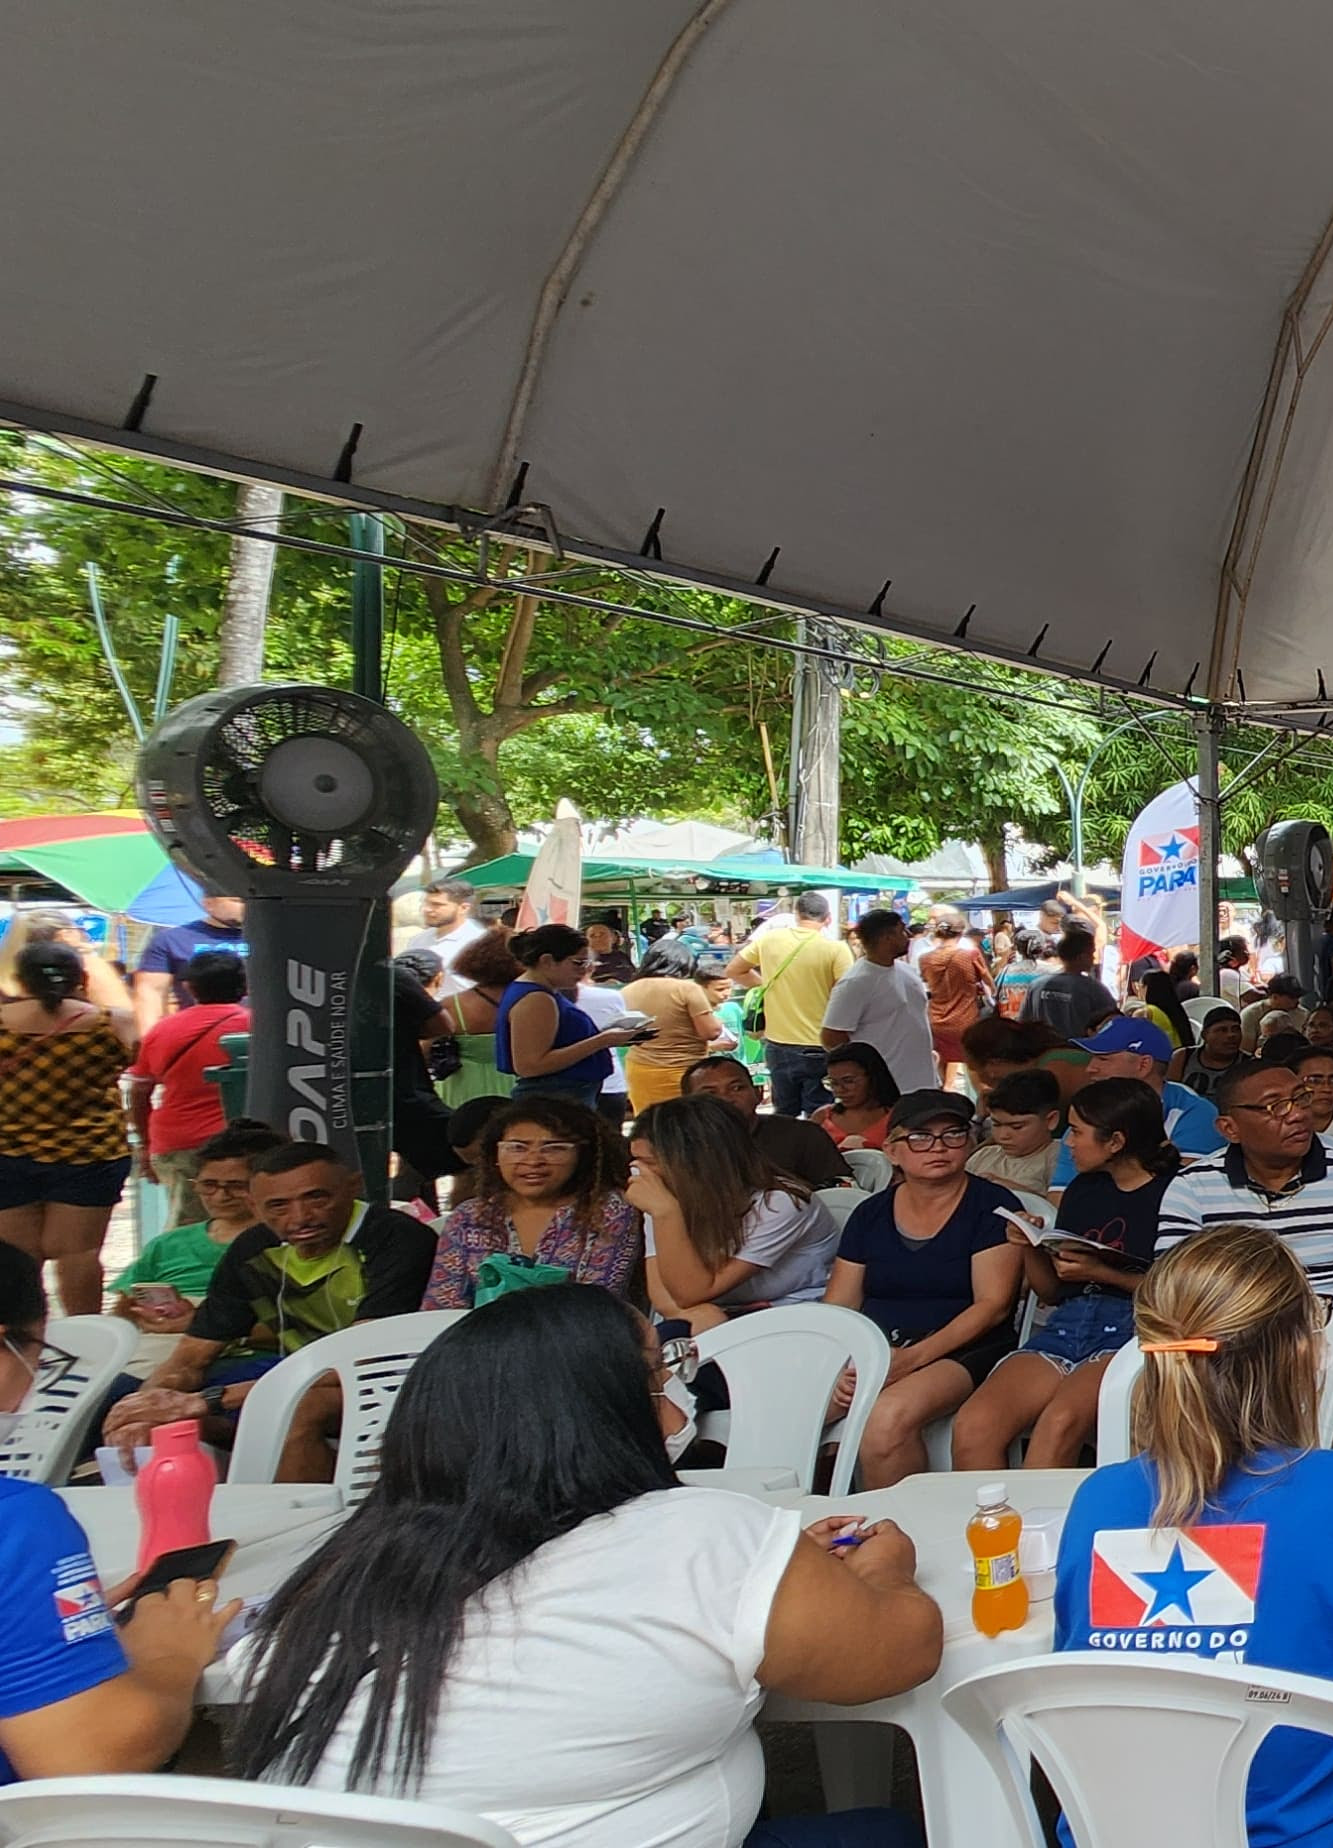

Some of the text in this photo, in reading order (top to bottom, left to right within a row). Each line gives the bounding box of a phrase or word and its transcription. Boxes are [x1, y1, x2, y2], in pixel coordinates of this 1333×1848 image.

[331, 970, 348, 992] AR
[330, 994, 346, 1017] NO
[326, 1021, 348, 1067] SAÚDE
[330, 1086, 348, 1130] CLIMA
[1089, 1629, 1249, 1650] GOVERNO DO
